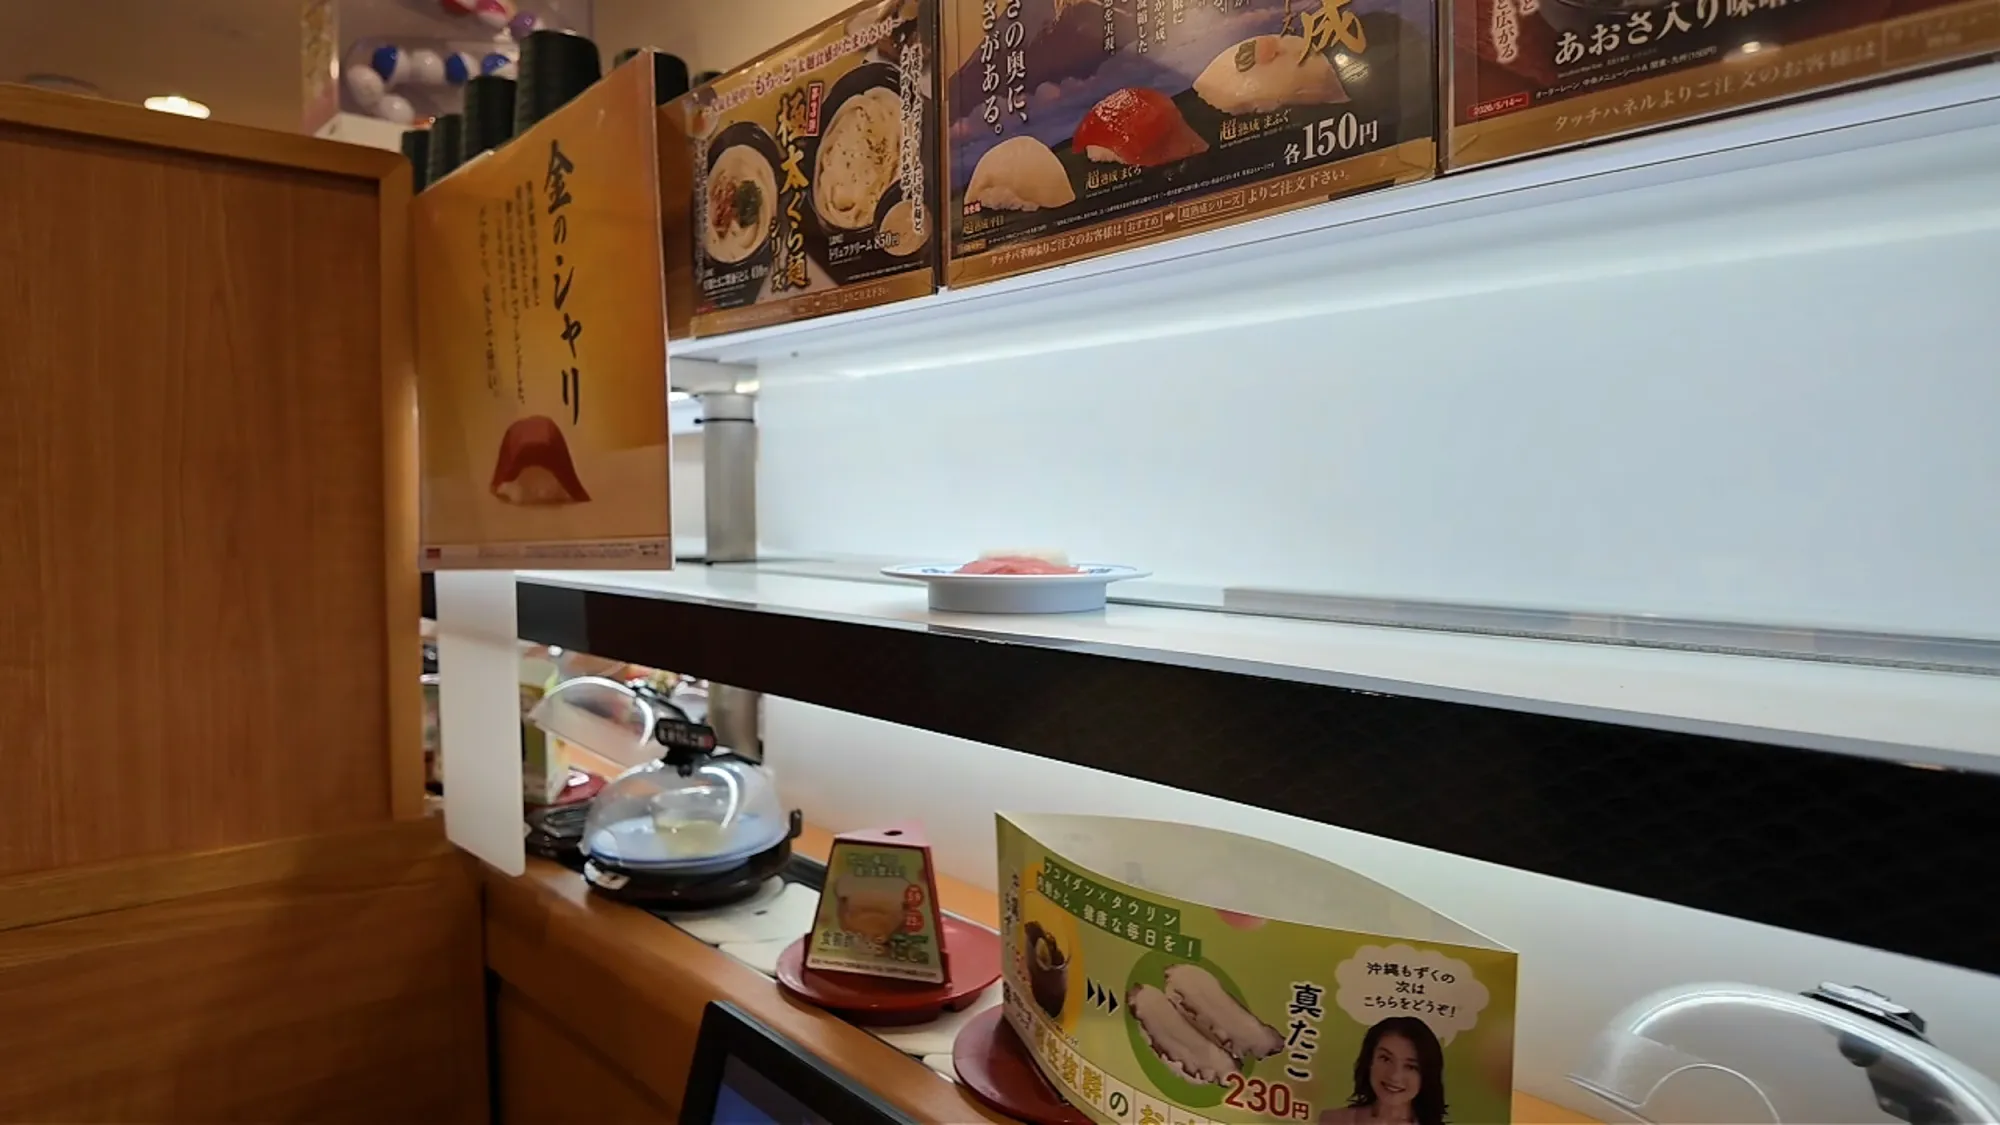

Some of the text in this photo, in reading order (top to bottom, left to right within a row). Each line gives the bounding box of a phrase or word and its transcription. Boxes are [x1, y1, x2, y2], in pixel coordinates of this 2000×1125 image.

[1284, 111, 1379, 166] 各150円
[1247, 169, 1350, 205] よりご注文下さい。
[544, 139, 583, 426] 金のシャリ
[1366, 961, 1456, 984] 沖縄もずくの
[1395, 981, 1425, 995] 次は
[1364, 996, 1456, 1018] こちらをどうぞ!
[1287, 984, 1323, 1079] 真たこ
[1224, 1073, 1310, 1121] 230円
